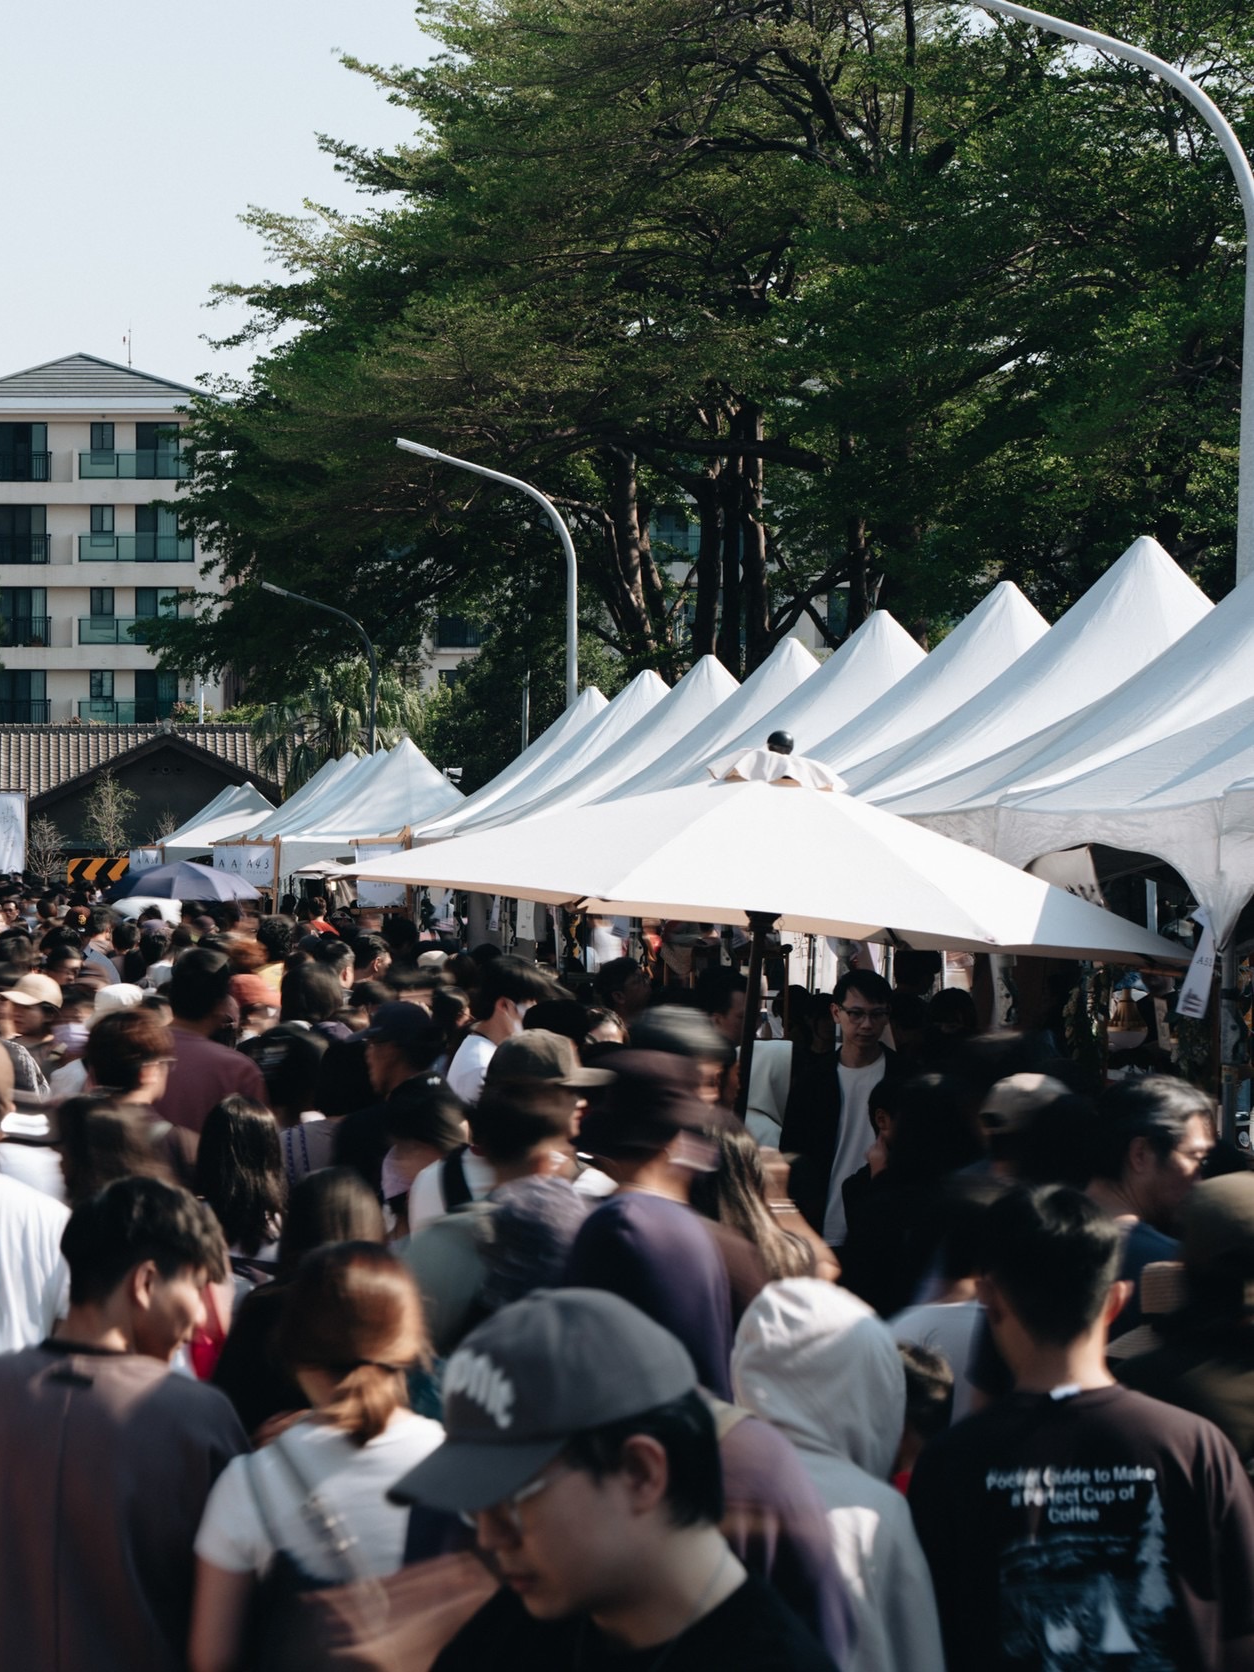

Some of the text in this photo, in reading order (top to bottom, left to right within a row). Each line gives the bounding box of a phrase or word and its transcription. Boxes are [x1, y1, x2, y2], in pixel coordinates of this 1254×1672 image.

[246, 858, 270, 869] A43
[1043, 1466, 1091, 1487] Guide
[1094, 1468, 1111, 1483] to
[1113, 1465, 1157, 1482] Make
[1011, 1485, 1135, 1507] a Perfect Cup of
[1048, 1506, 1100, 1523] Coffee
